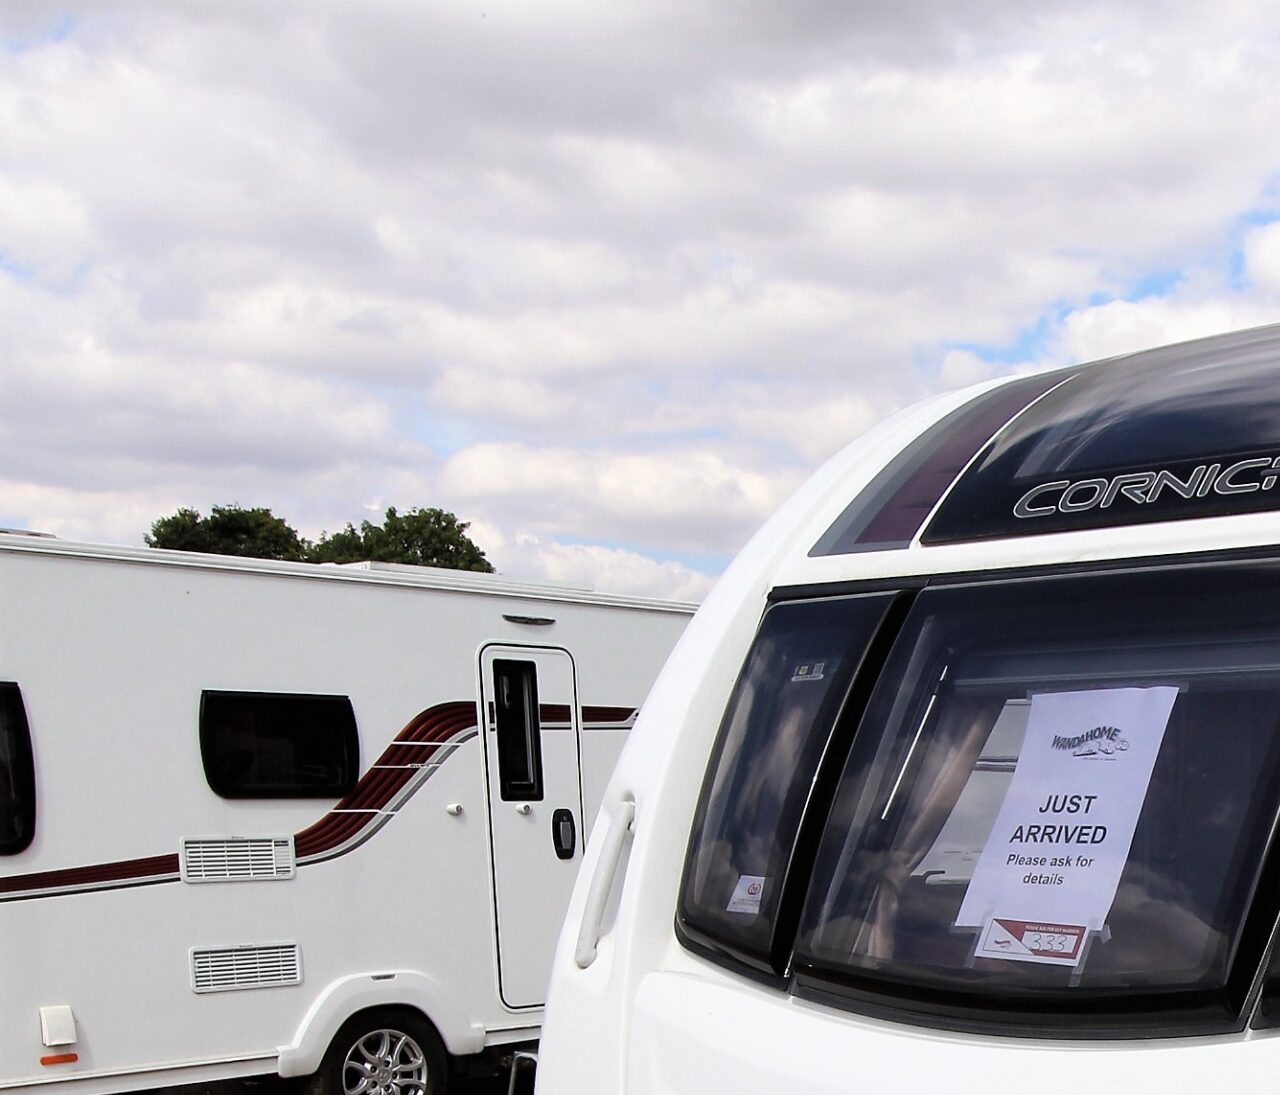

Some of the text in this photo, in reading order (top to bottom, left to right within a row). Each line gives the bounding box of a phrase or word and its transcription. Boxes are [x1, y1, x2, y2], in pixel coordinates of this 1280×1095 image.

[1052, 725, 1121, 750] WANDAHOME
[1039, 795, 1097, 814] JUST
[1008, 825, 1108, 845] ARRIVED
[1006, 853, 1095, 868] Please ask for
[1022, 872, 1064, 886] details
[1030, 933, 1068, 951] 333
